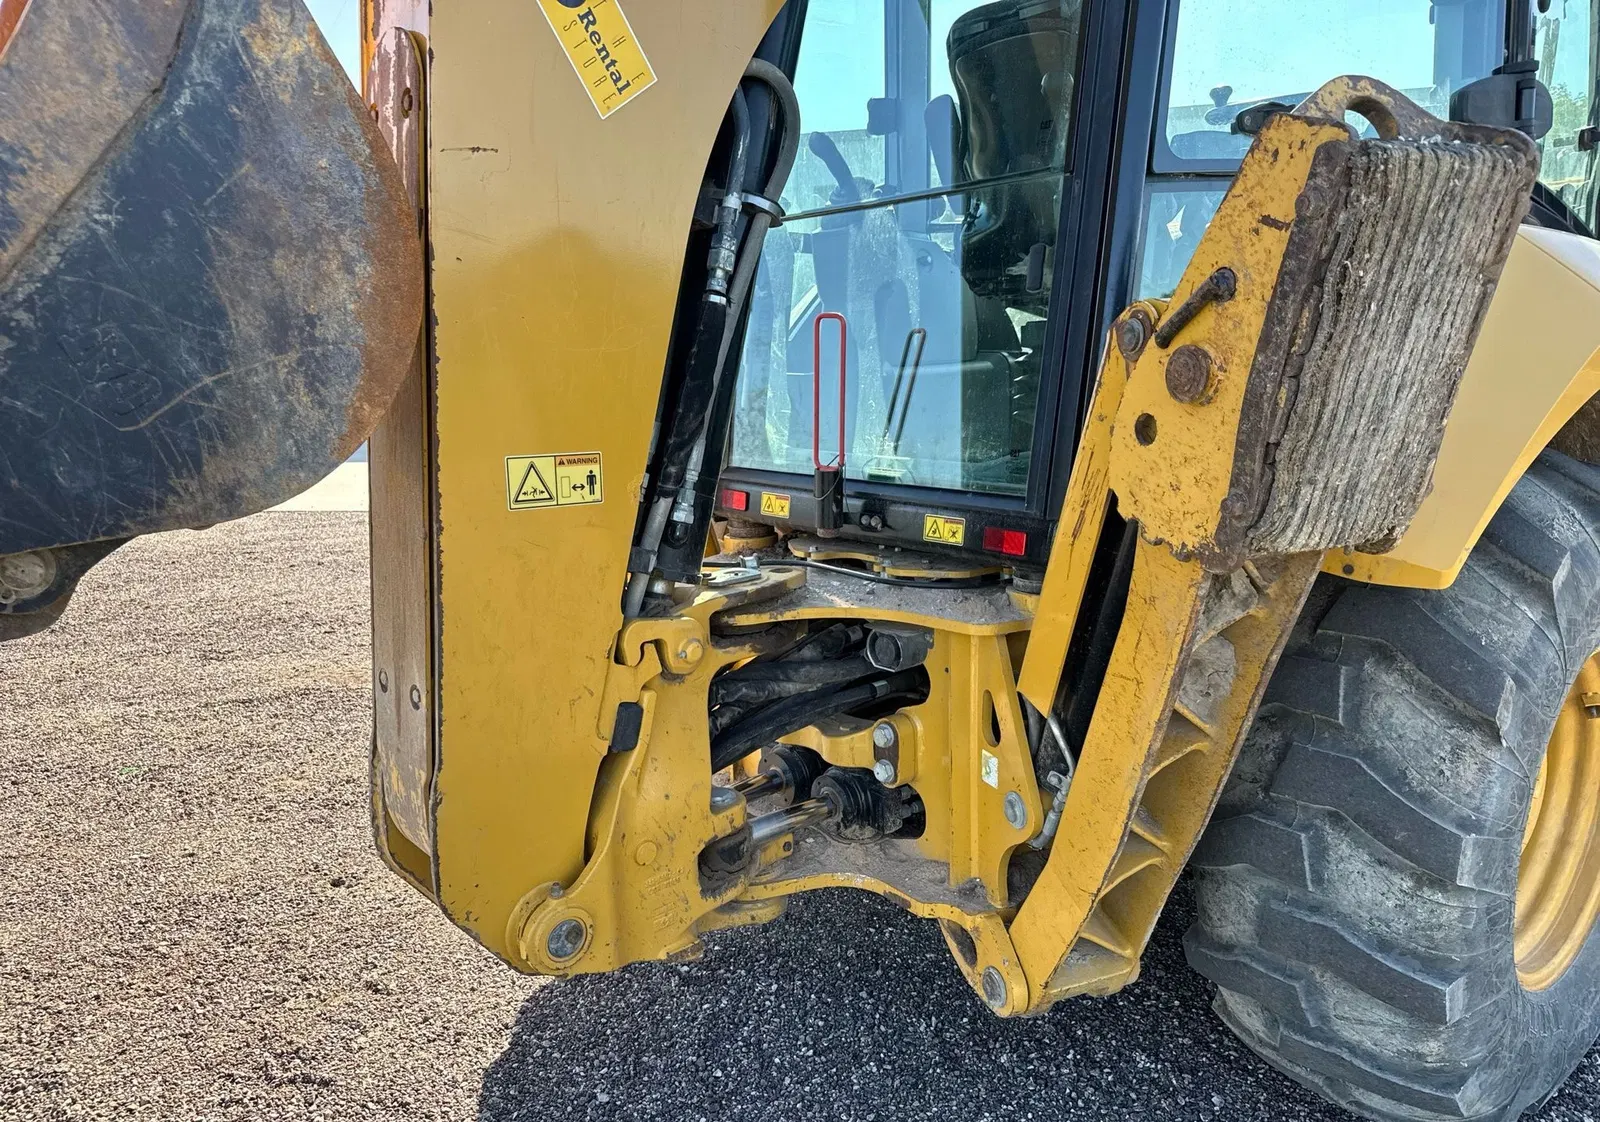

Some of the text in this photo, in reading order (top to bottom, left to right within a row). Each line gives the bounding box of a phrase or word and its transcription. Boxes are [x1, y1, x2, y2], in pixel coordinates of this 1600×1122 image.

[563, 20, 617, 104] STORE
[577, 7, 631, 95] Rental
[566, 457, 598, 465] WARNING
